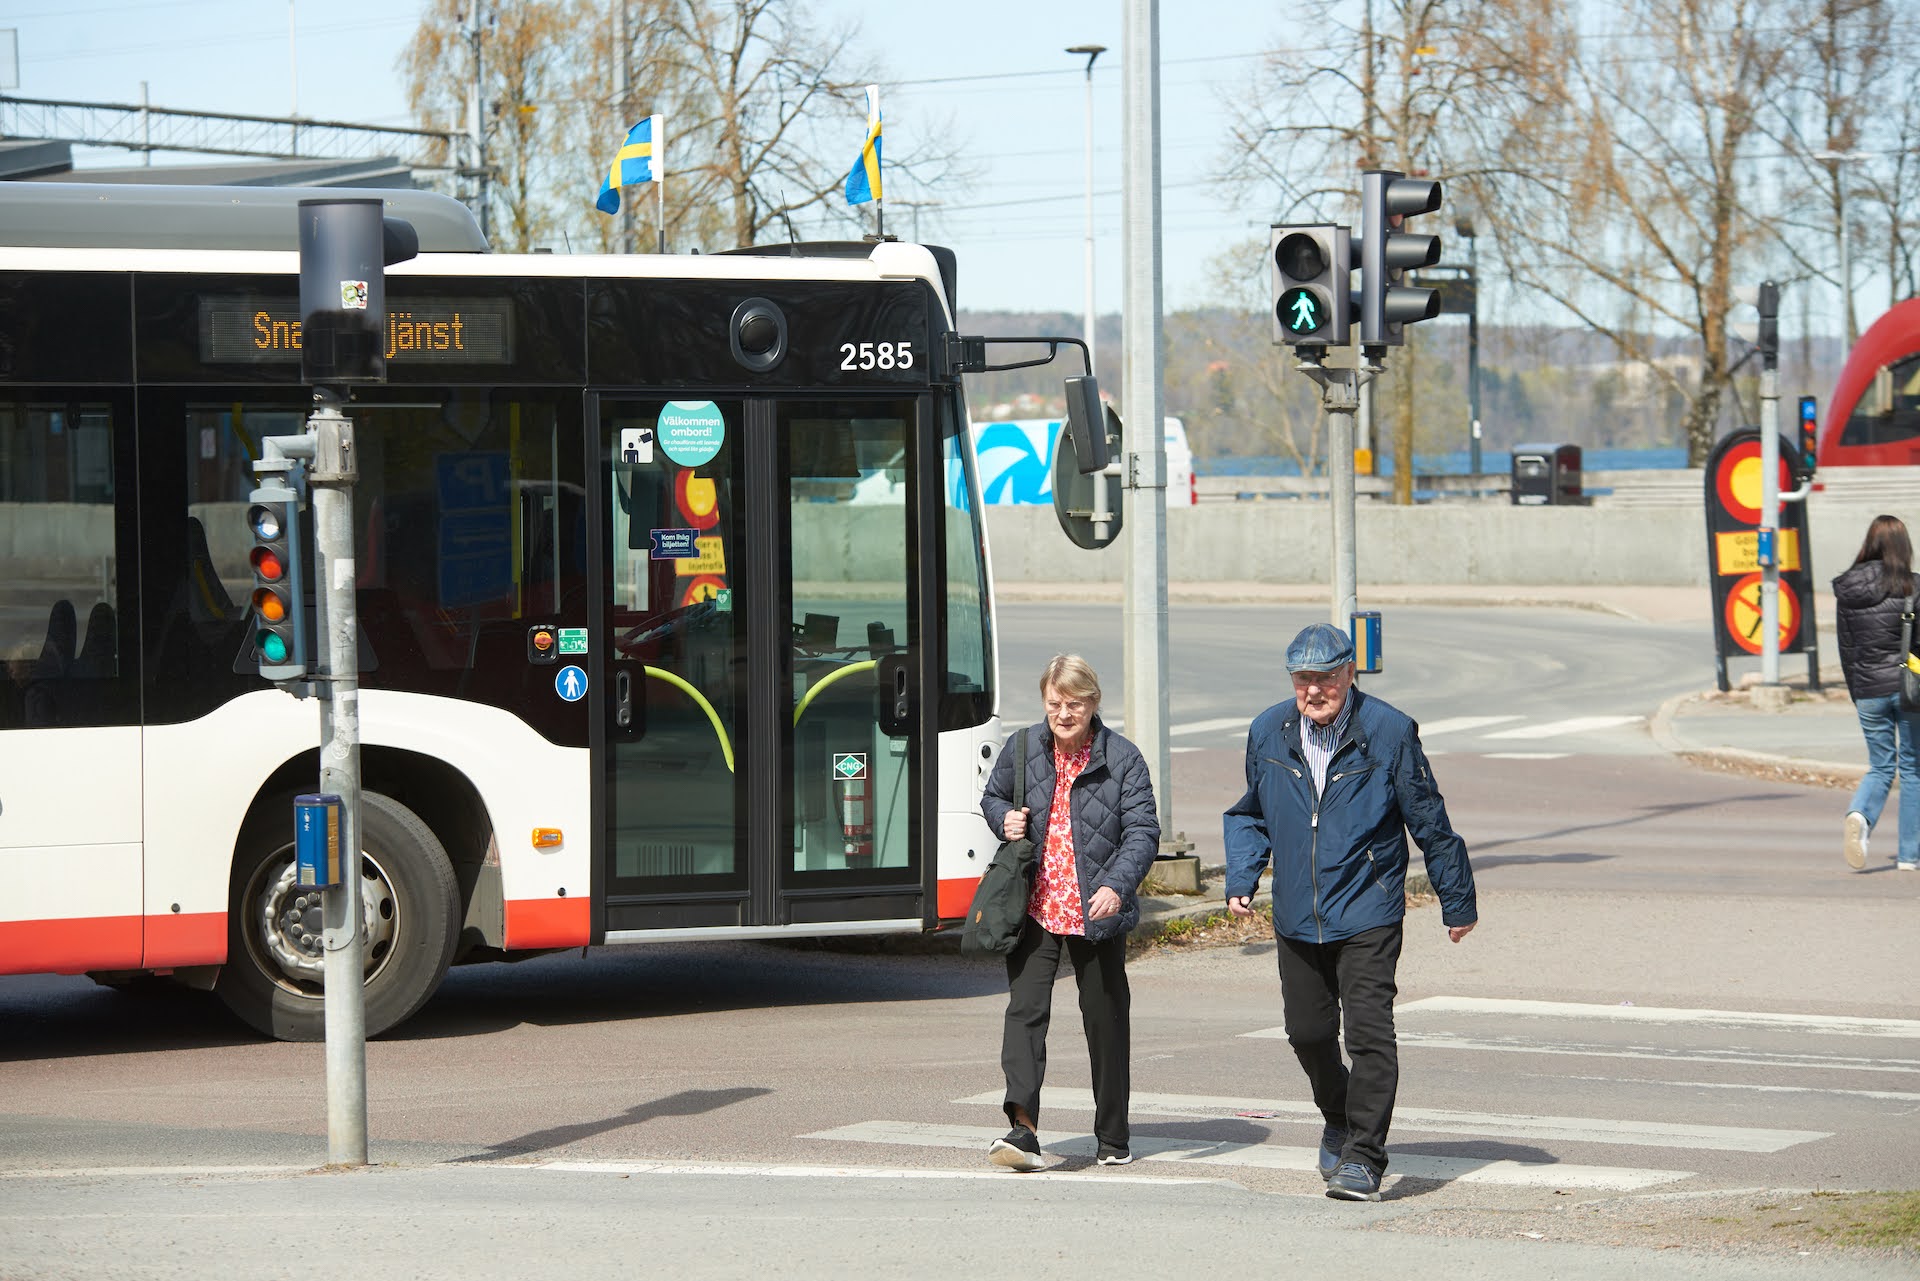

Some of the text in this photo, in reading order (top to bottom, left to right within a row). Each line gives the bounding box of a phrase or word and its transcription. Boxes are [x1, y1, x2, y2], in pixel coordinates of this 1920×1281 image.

[254, 311, 464, 359] Sna jänst
[840, 342, 914, 371] 2585
[662, 416, 720, 426] Välkommen
[671, 427, 713, 436] ombord!
[840, 762, 860, 771] CNG
